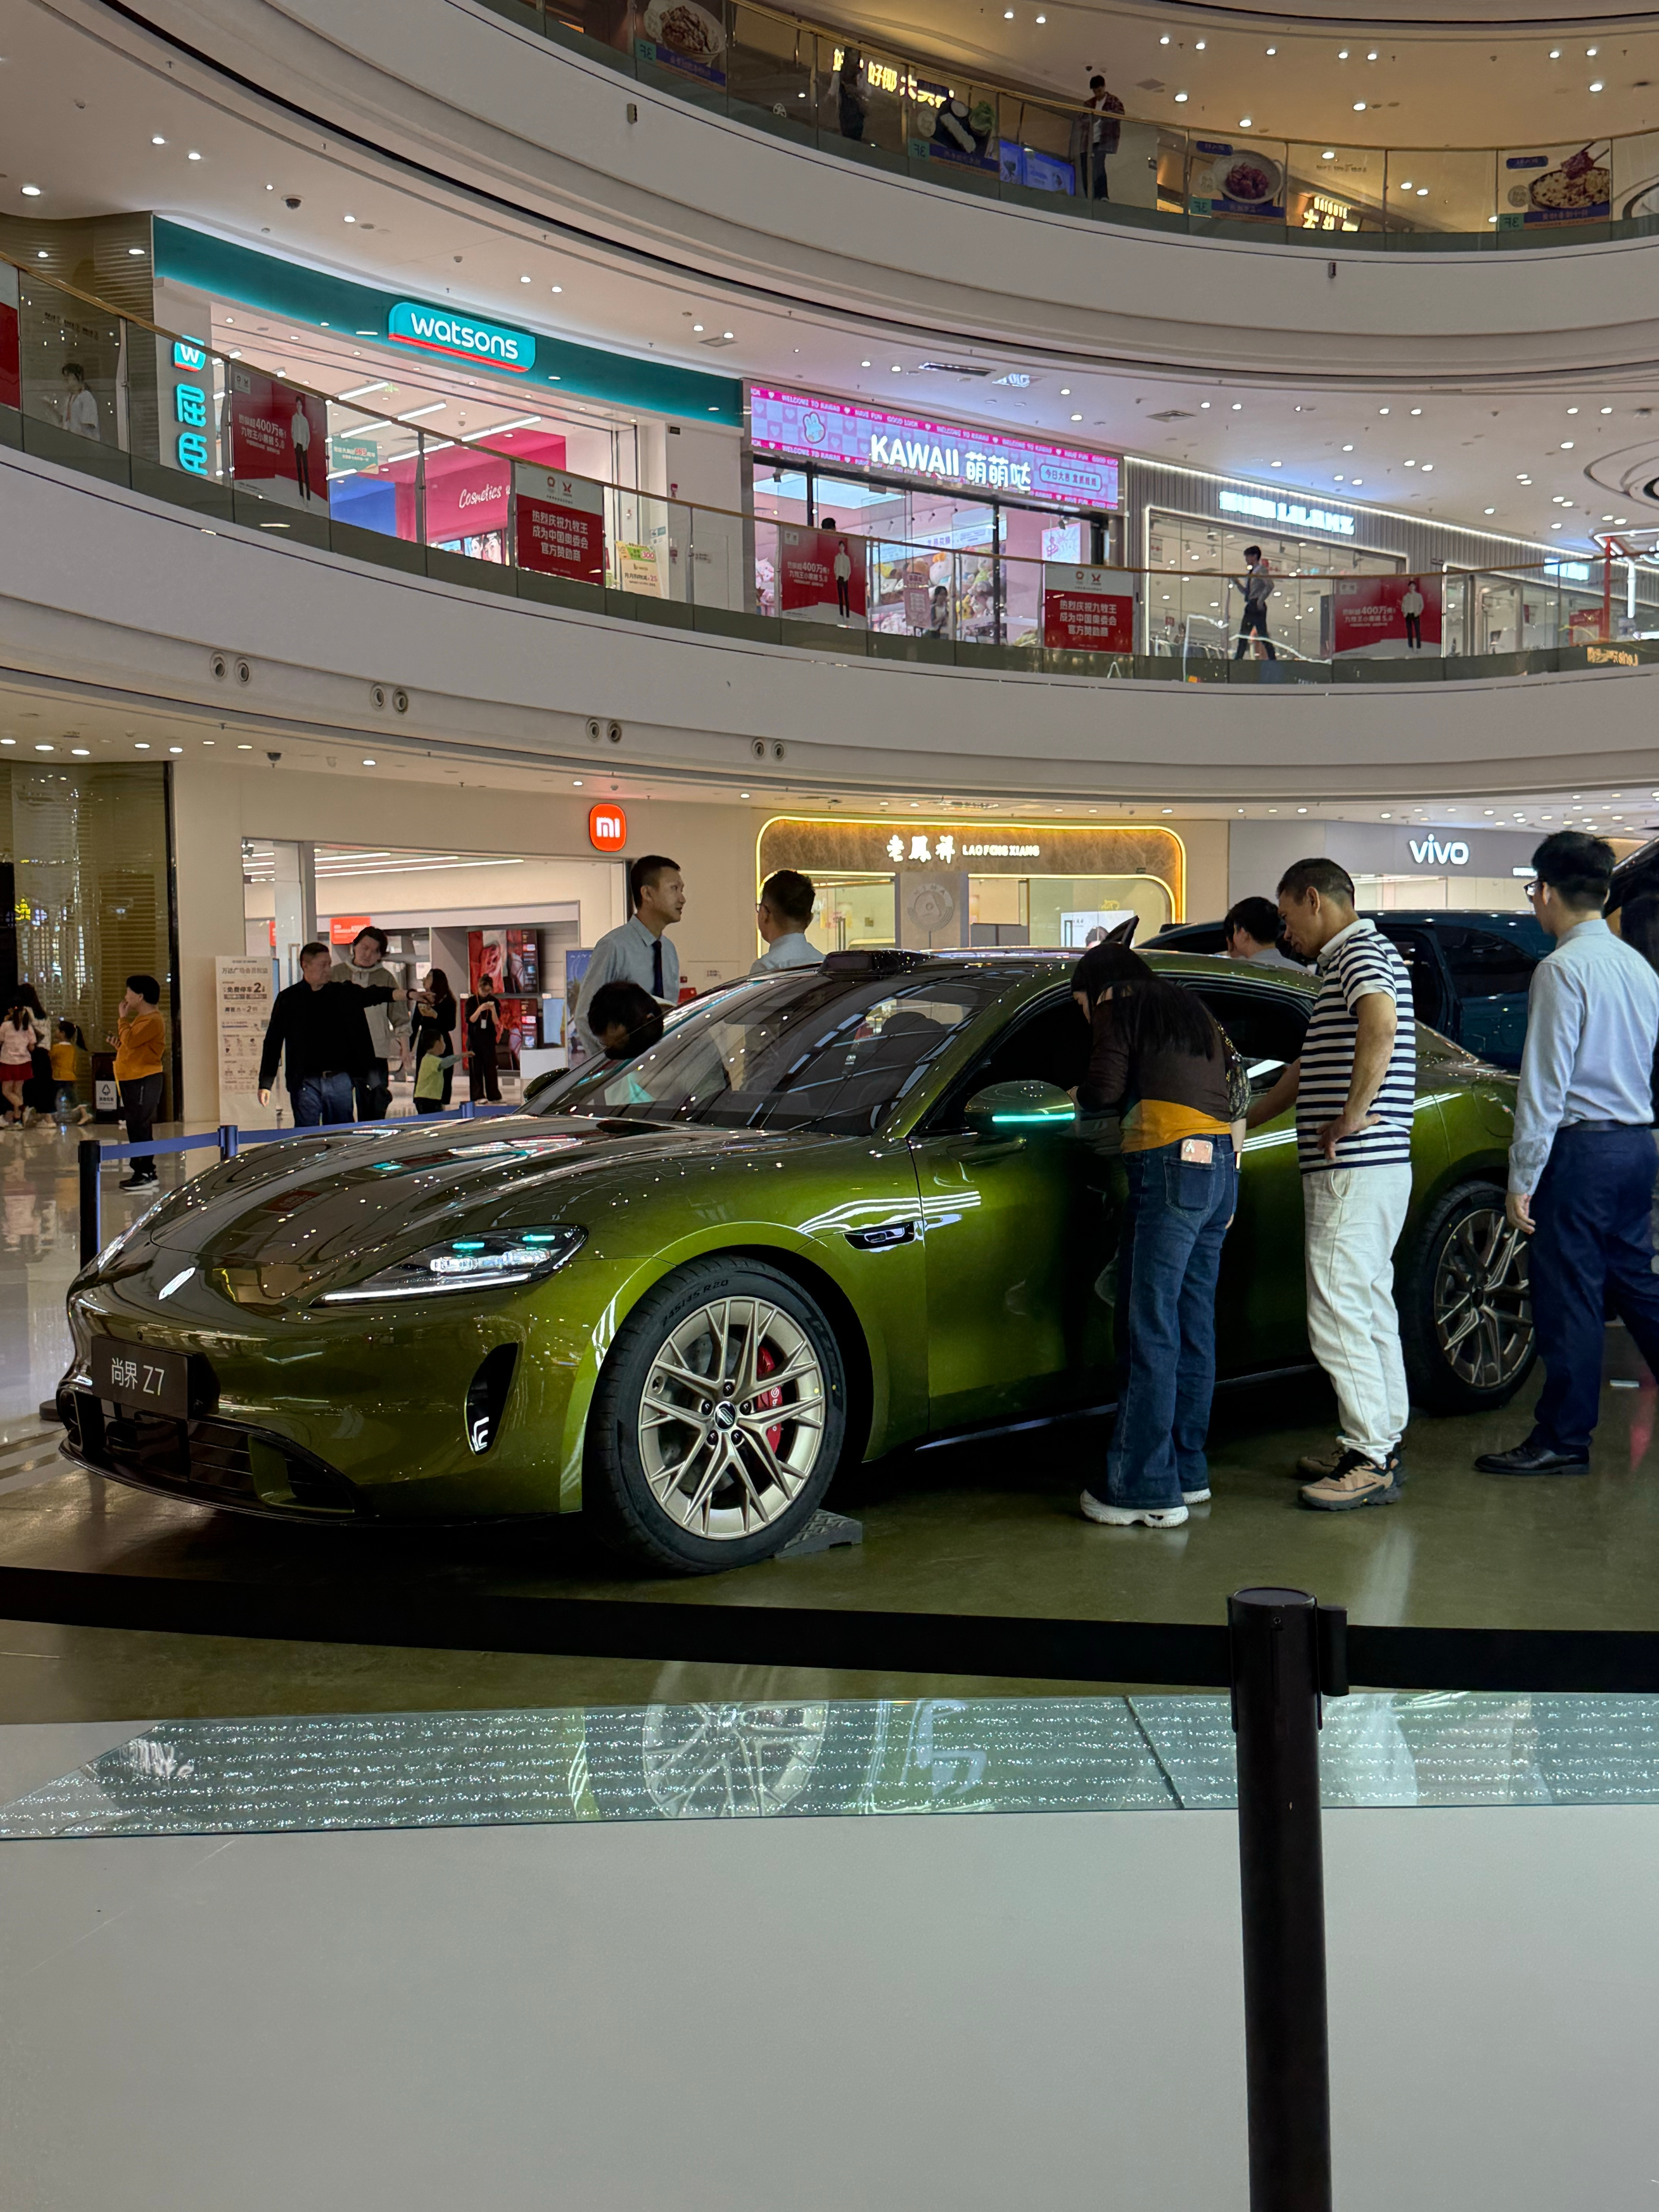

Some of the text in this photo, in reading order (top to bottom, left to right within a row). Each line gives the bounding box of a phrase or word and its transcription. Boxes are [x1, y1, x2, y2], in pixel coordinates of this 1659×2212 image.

[411, 313, 518, 359] watsons
[871, 434, 959, 476] KAWAII
[965, 451, 1031, 491] 萌萌哒
[459, 483, 502, 508] Cosmetics
[532, 510, 588, 535] 热烈庆祝九牧王
[532, 525, 588, 549] 成为中国奥委会
[541, 542, 581, 562] 官方赞助商
[1060, 612, 1117, 626] 成为中国奥委会
[1409, 834, 1469, 864] vivo
[112, 1357, 165, 1396] 尚界 Z7
